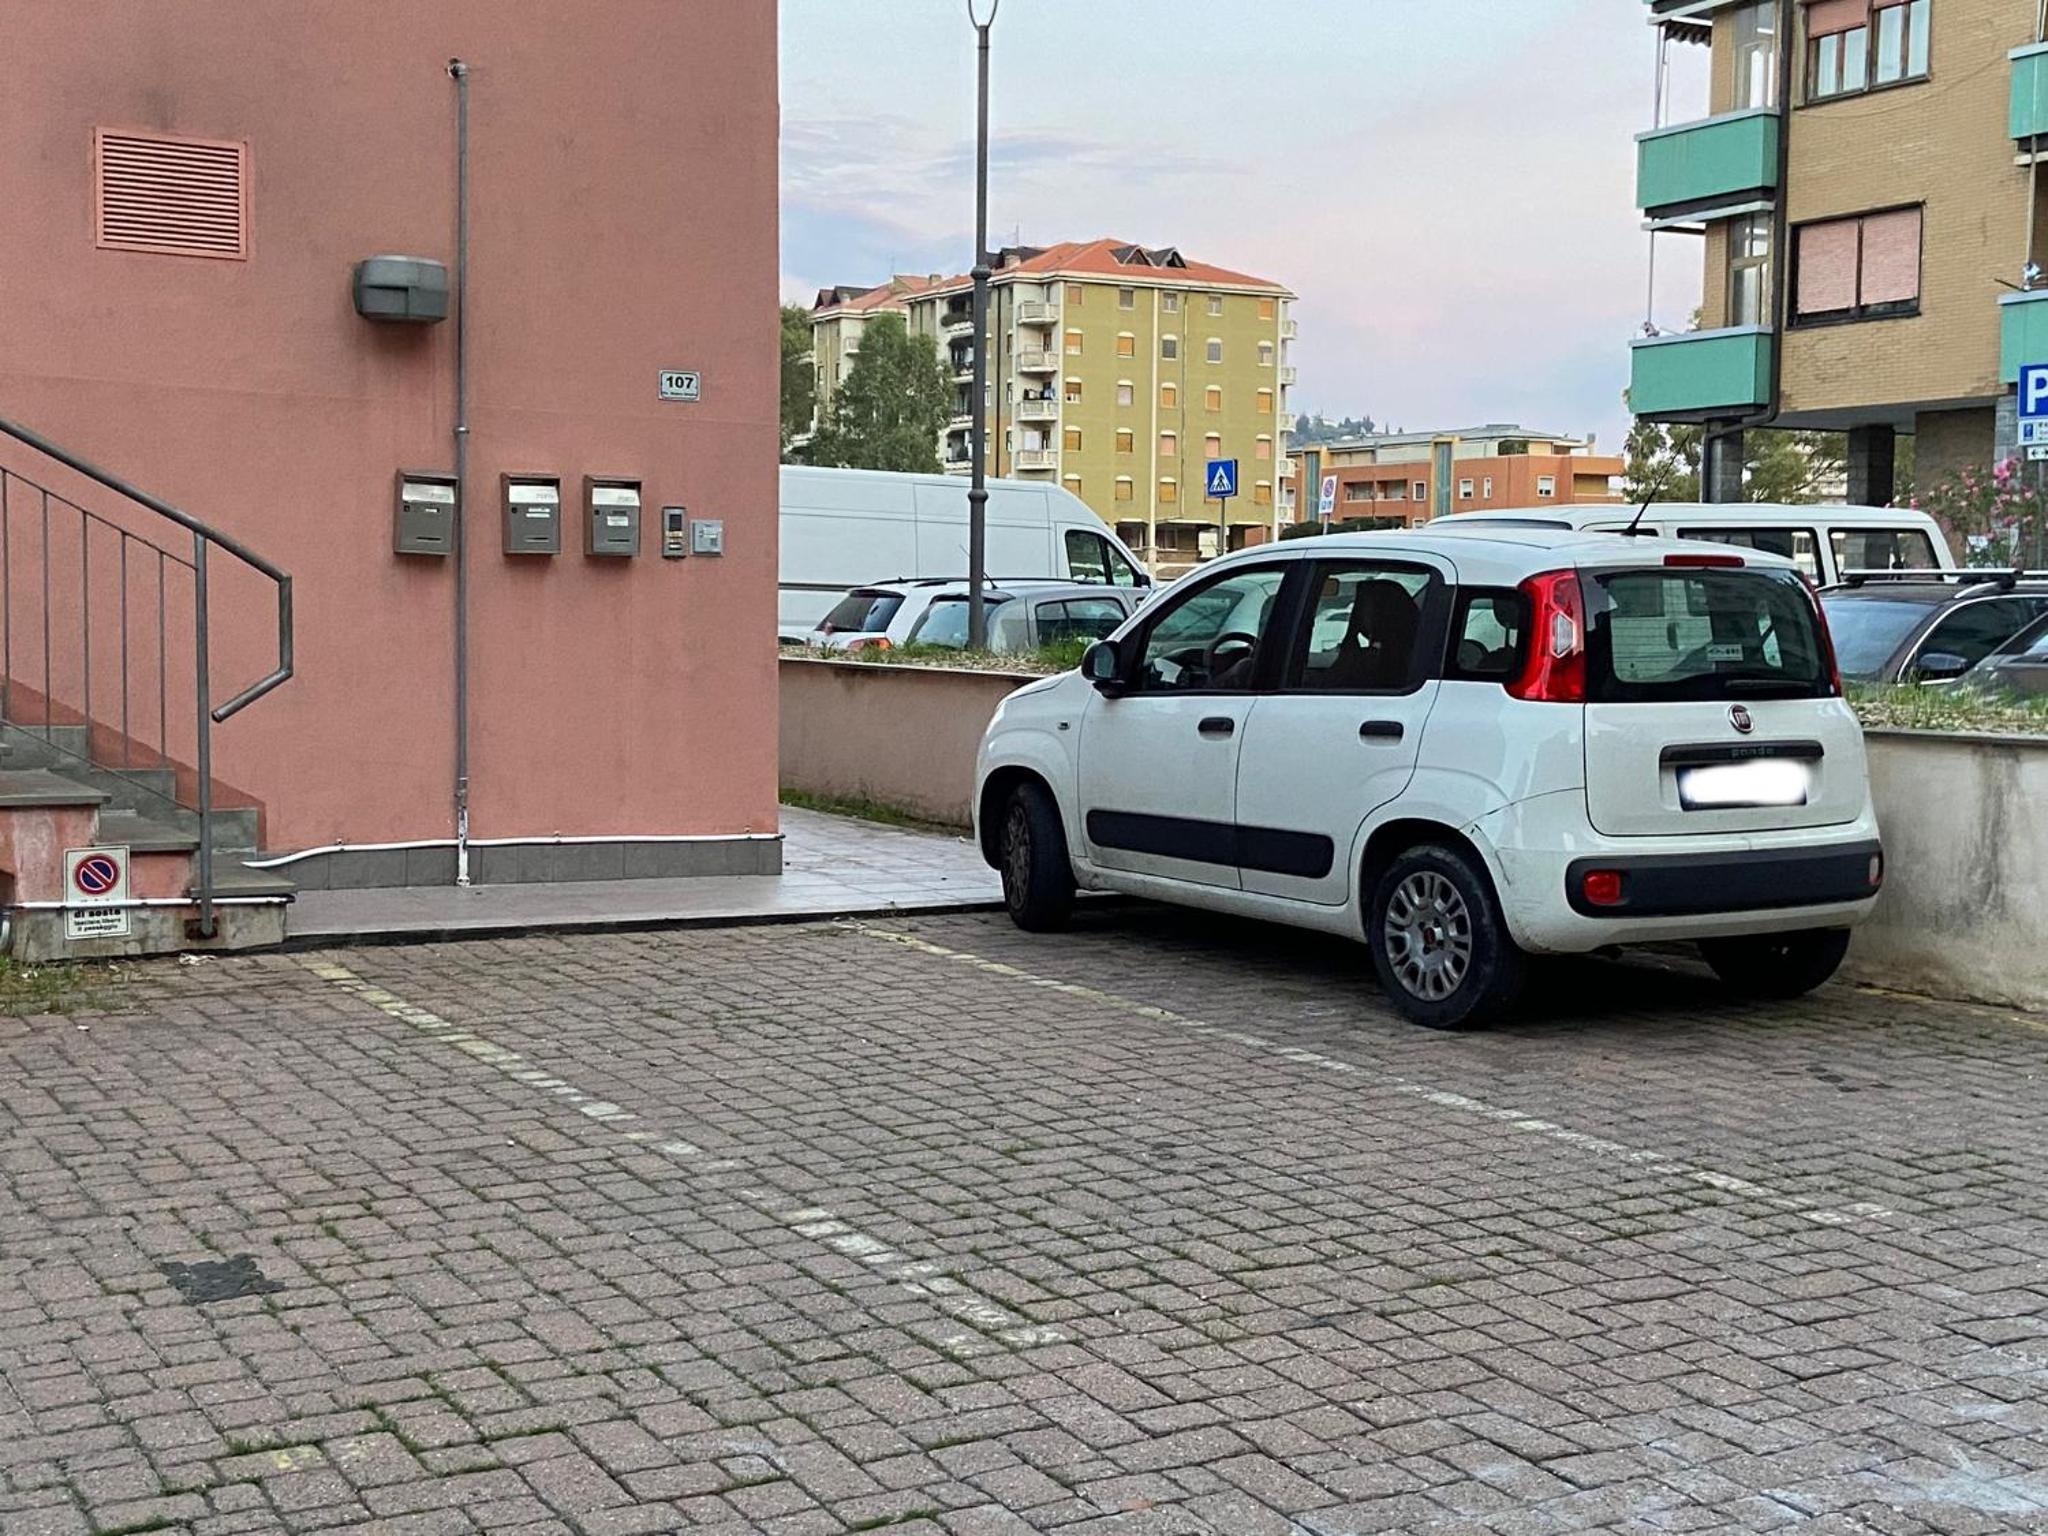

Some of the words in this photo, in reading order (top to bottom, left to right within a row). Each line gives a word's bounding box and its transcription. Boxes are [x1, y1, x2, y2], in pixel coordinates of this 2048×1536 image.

[666, 376, 694, 389] 107
[2026, 368, 2048, 413] P
[89, 908, 121, 917] sosta
